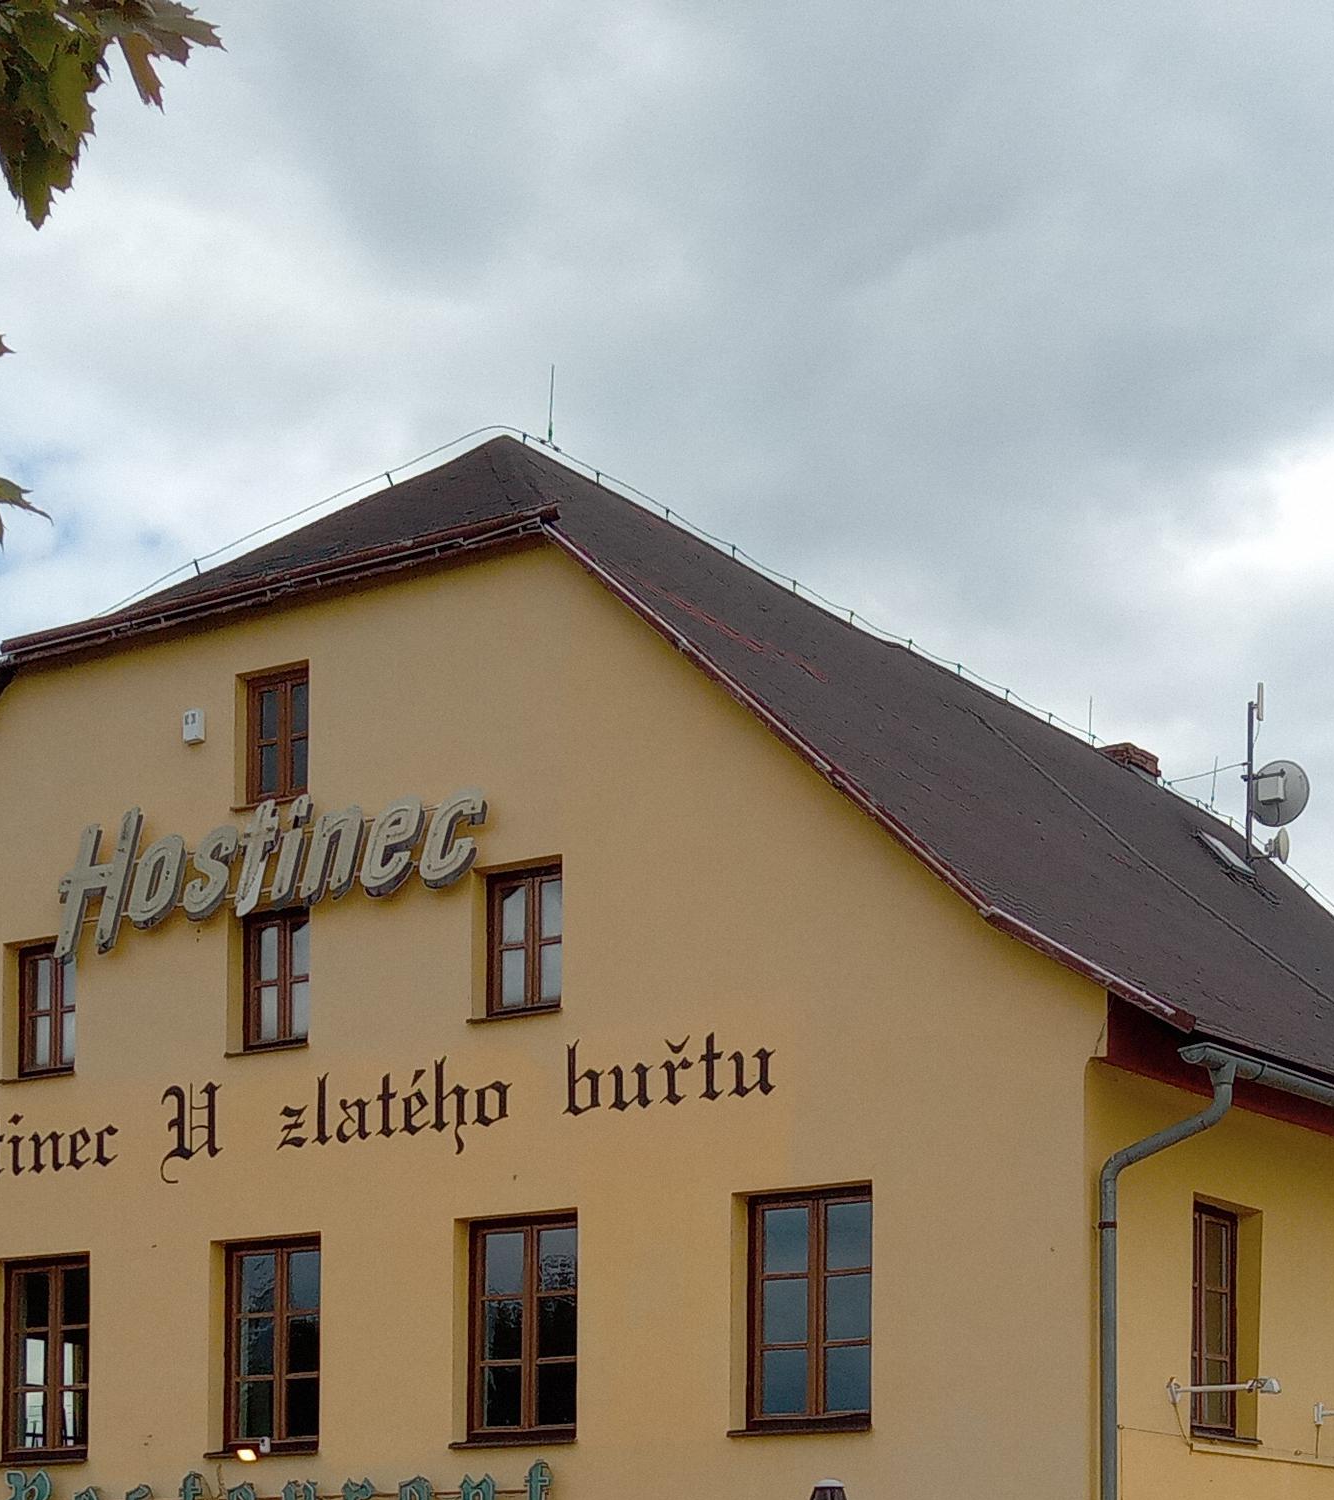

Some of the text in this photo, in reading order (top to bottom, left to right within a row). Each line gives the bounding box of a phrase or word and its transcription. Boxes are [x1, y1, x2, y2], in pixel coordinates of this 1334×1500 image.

[54, 793, 488, 962] Hostinec
[160, 1081, 223, 1184] U
[276, 1055, 513, 1155] zlatého
[562, 1032, 777, 1116] buřtu
